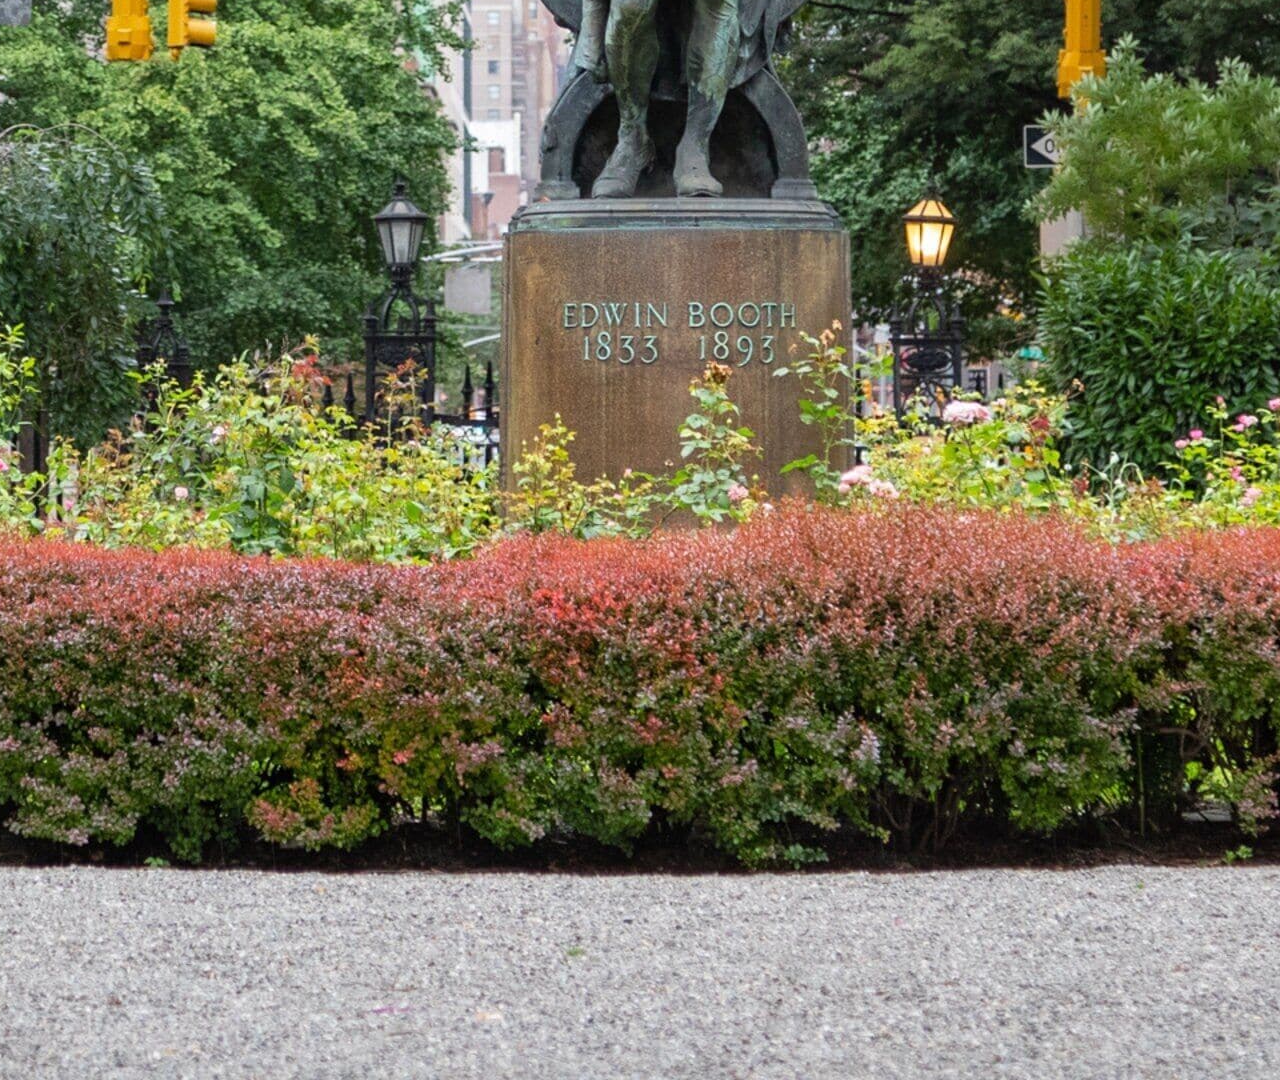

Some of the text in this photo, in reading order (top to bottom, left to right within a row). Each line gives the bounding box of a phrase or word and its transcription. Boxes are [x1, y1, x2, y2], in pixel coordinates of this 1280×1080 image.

[563, 302, 797, 328] EDWIN BOOTH
[583, 331, 775, 367] 1833 1893
